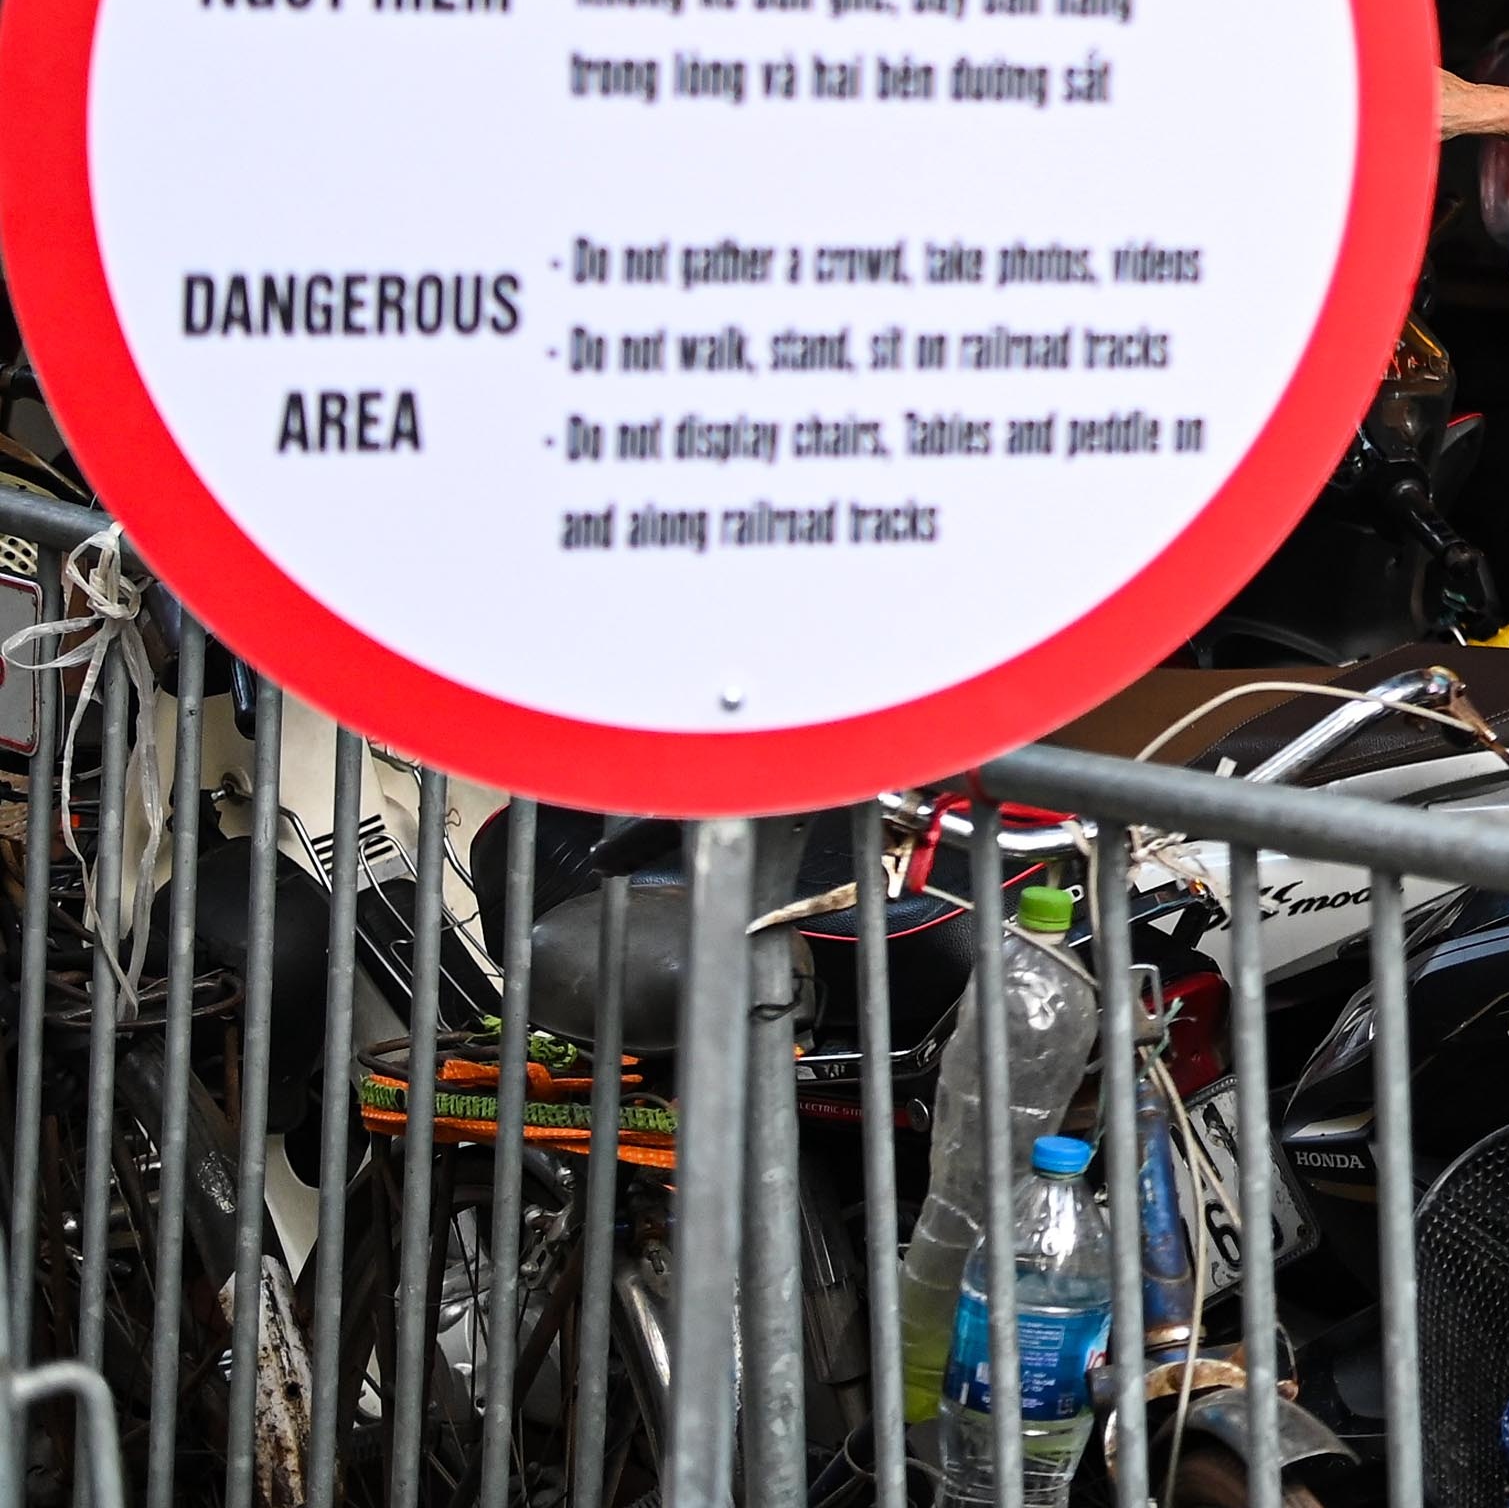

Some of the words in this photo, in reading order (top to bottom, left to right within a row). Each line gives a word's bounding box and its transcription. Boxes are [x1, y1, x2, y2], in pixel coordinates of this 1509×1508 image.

[573, 236, 610, 284] Do
[626, 242, 669, 283] not
[681, 238, 775, 290] gather
[787, 247, 801, 283] a
[815, 241, 911, 284] crowd,
[926, 241, 984, 283] take
[997, 242, 1098, 287] photos,
[1113, 242, 1201, 283] videos
[183, 272, 520, 336] DANGEROUS
[570, 325, 606, 373] Do
[620, 329, 665, 372] not
[678, 325, 756, 373] walk,
[771, 328, 856, 372] stand,
[871, 326, 903, 370] sit
[916, 333, 947, 370] on
[960, 325, 1072, 369] railroad
[1084, 327, 1169, 368] tracks
[277, 389, 422, 453] AREA
[567, 414, 602, 462] Do
[617, 418, 662, 460] not
[674, 413, 780, 463] display
[793, 415, 890, 457] chairs,
[1006, 413, 1055, 455] and
[1067, 410, 1160, 458] peddle
[1175, 418, 1204, 452] on
[561, 504, 615, 550] and
[627, 504, 709, 553] along
[721, 500, 837, 546] railroad
[850, 500, 938, 543] tracks
[798, 1101, 839, 1114] LECTRIC
[1295, 1150, 1366, 1170] HONDA
